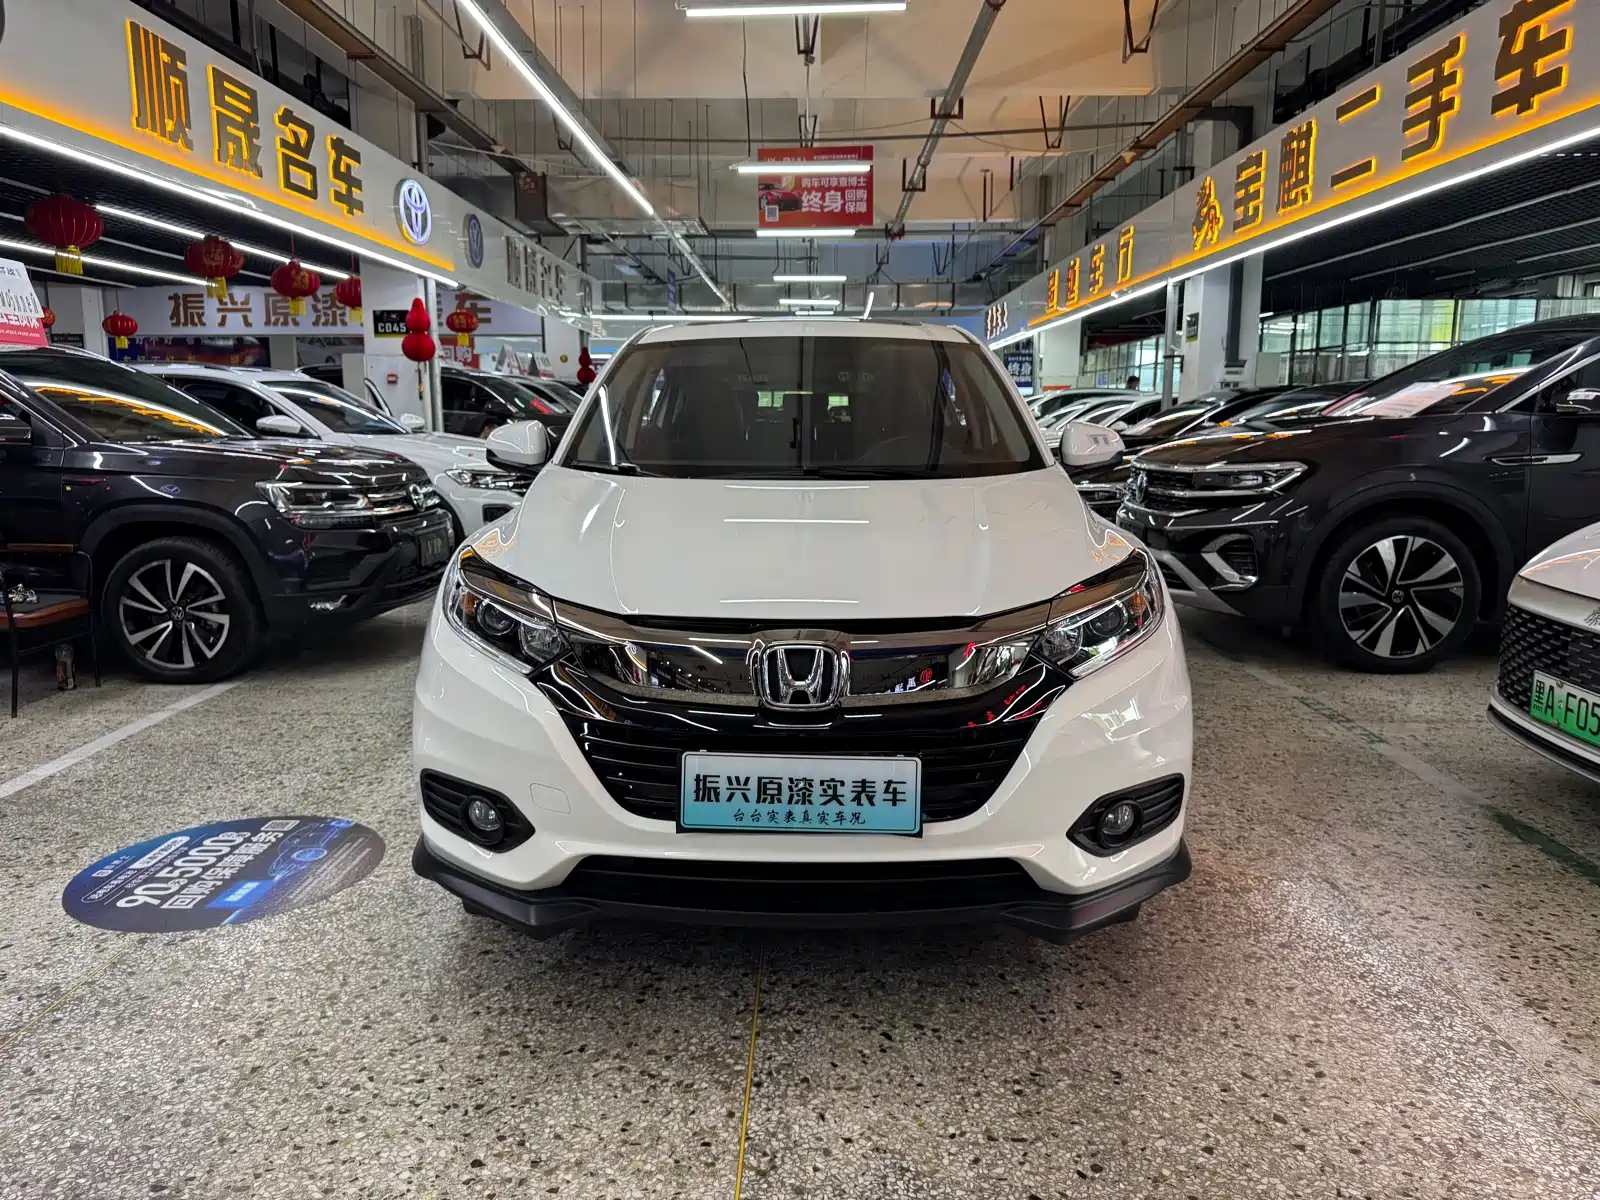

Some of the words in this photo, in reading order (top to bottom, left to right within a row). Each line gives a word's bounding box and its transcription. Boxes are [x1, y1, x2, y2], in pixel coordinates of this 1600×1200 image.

[125, 18, 364, 217] 顺晟名车
[1233, 0, 1574, 233] 宝麒二手车
[801, 190, 844, 213] 终身
[845, 189, 867, 201] 回购
[845, 201, 867, 213] 保障
[378, 323, 407, 333] C045
[693, 773, 908, 807] 振兴原漆实表车
[732, 808, 867, 826] 台台实表真实车况
[159, 831, 285, 909] 回购保障服务
